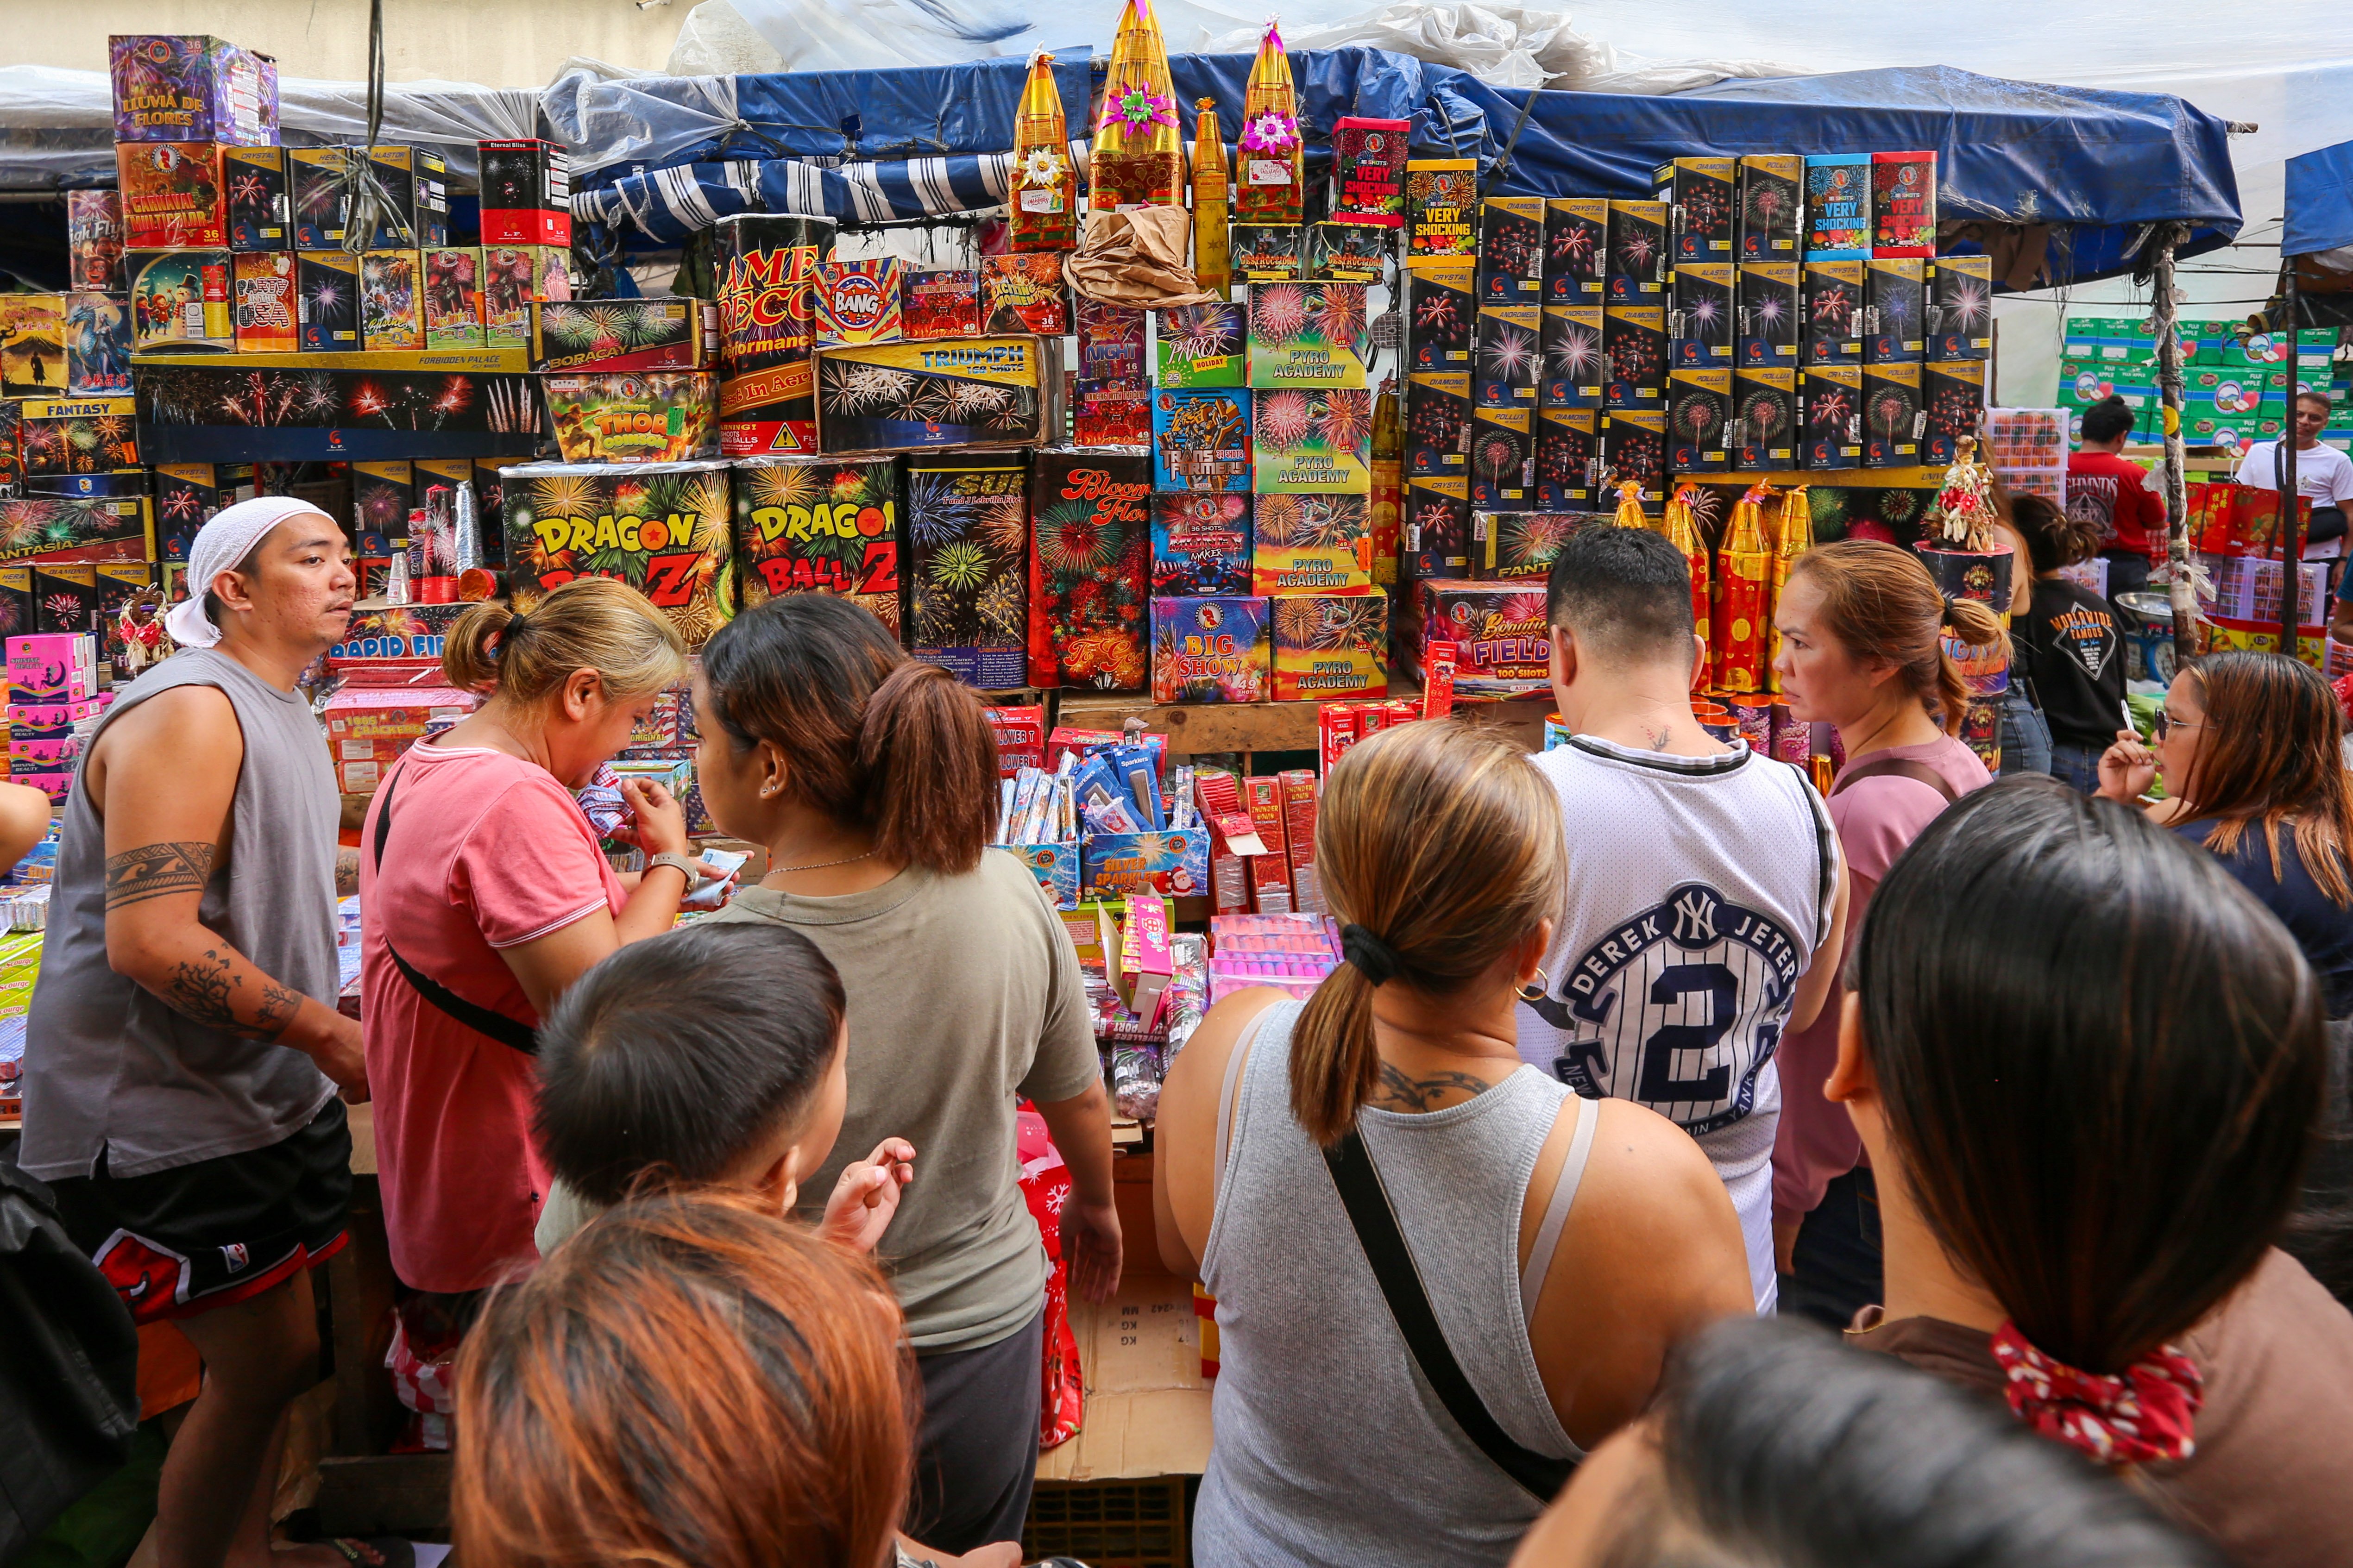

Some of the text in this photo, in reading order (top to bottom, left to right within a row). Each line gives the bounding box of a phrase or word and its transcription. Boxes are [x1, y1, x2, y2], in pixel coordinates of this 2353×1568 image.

[187, 41, 201, 50] 36
[123, 95, 203, 113] LLUVIA DE
[135, 112, 194, 127] FLORES
[1356, 167, 1390, 182] VERY
[1345, 181, 1400, 195] SHOCKING
[132, 193, 196, 213] CARNAVAL
[1824, 202, 1857, 218] VERY
[1890, 200, 1924, 214] VERY
[129, 211, 208, 232] MULTICOLOR
[1425, 207, 1461, 223] VERY
[1881, 214, 1932, 227] SHOCKING
[1416, 223, 1470, 236] SHOCKING
[1815, 217, 1867, 231] SHOCKING
[203, 230, 219, 238] 36
[236, 277, 289, 296] PARTY
[912, 282, 972, 294] DANCING WITH THE DEVIL
[991, 282, 1037, 301] EXCITING
[248, 294, 277, 303] IN THE
[833, 290, 879, 315] BANG
[239, 302, 289, 328] USA
[428, 311, 476, 327] Business
[1089, 324, 1125, 342] SKY
[721, 332, 816, 361] Performance
[1085, 343, 1137, 362] NIGHT
[1168, 332, 1228, 366] PARTY
[419, 355, 500, 365] FORBIDDEN PALACE
[549, 345, 629, 369] BORACAY
[920, 345, 1024, 367] TRIUMPH
[1290, 350, 1329, 364] PYRO
[966, 364, 1024, 374] 168 SHOTS
[1196, 358, 1224, 369] HOLIDAY
[1273, 364, 1346, 378] ACADEMY
[721, 388, 742, 408] Best
[745, 377, 768, 401] In
[1085, 392, 1107, 402] DANCING
[1122, 391, 1132, 400] THE
[1133, 390, 1147, 399] DEVIL
[47, 403, 111, 416] FANTASY
[593, 413, 668, 436] THOR
[603, 433, 669, 451] ODINSON
[1160, 449, 1214, 472] TRANS
[1294, 456, 1334, 470] PYRO
[1170, 462, 1246, 483] FORMERS
[1277, 470, 1350, 483] ACADEMY
[533, 511, 701, 555] DRAGON
[1168, 533, 1243, 552] MONEY
[1191, 548, 1223, 560] MAKER
[757, 541, 898, 596] BALL Z
[1293, 559, 1333, 573] PYRO
[648, 552, 699, 607] Z
[1277, 572, 1349, 587] ACADEMY
[2050, 611, 2112, 632] WORLDWIDE
[2071, 627, 2103, 639] FAMOUS
[1184, 634, 1234, 656] BIG
[2253, 636, 2268, 645] 120
[1063, 639, 1146, 672] To God
[1179, 659, 1242, 677] SHOW
[1313, 661, 1353, 675] PYRO
[1497, 668, 1548, 678] 100 SHOTS
[1297, 675, 1368, 689] ACADEMY
[353, 724, 424, 737] CRACKERS
[1029, 730, 1035, 741] T
[1032, 754, 1038, 766] T
[1121, 756, 1149, 767] Sparklers
[1286, 784, 1313, 793] THUNDER
[1252, 804, 1279, 813] THUNDER
[1103, 858, 1146, 872] SILVER
[1095, 872, 1160, 886] SPARKLER
[1572, 915, 1662, 995] DEREK
[1734, 916, 1797, 984] JETER
[6, 958, 33, 968] Scourge
[0, 980, 29, 991] Scourge
[1637, 963, 1739, 1103] 2
[1121, 1321, 1137, 1330] KG
[1120, 1336, 1137, 1345] KG
